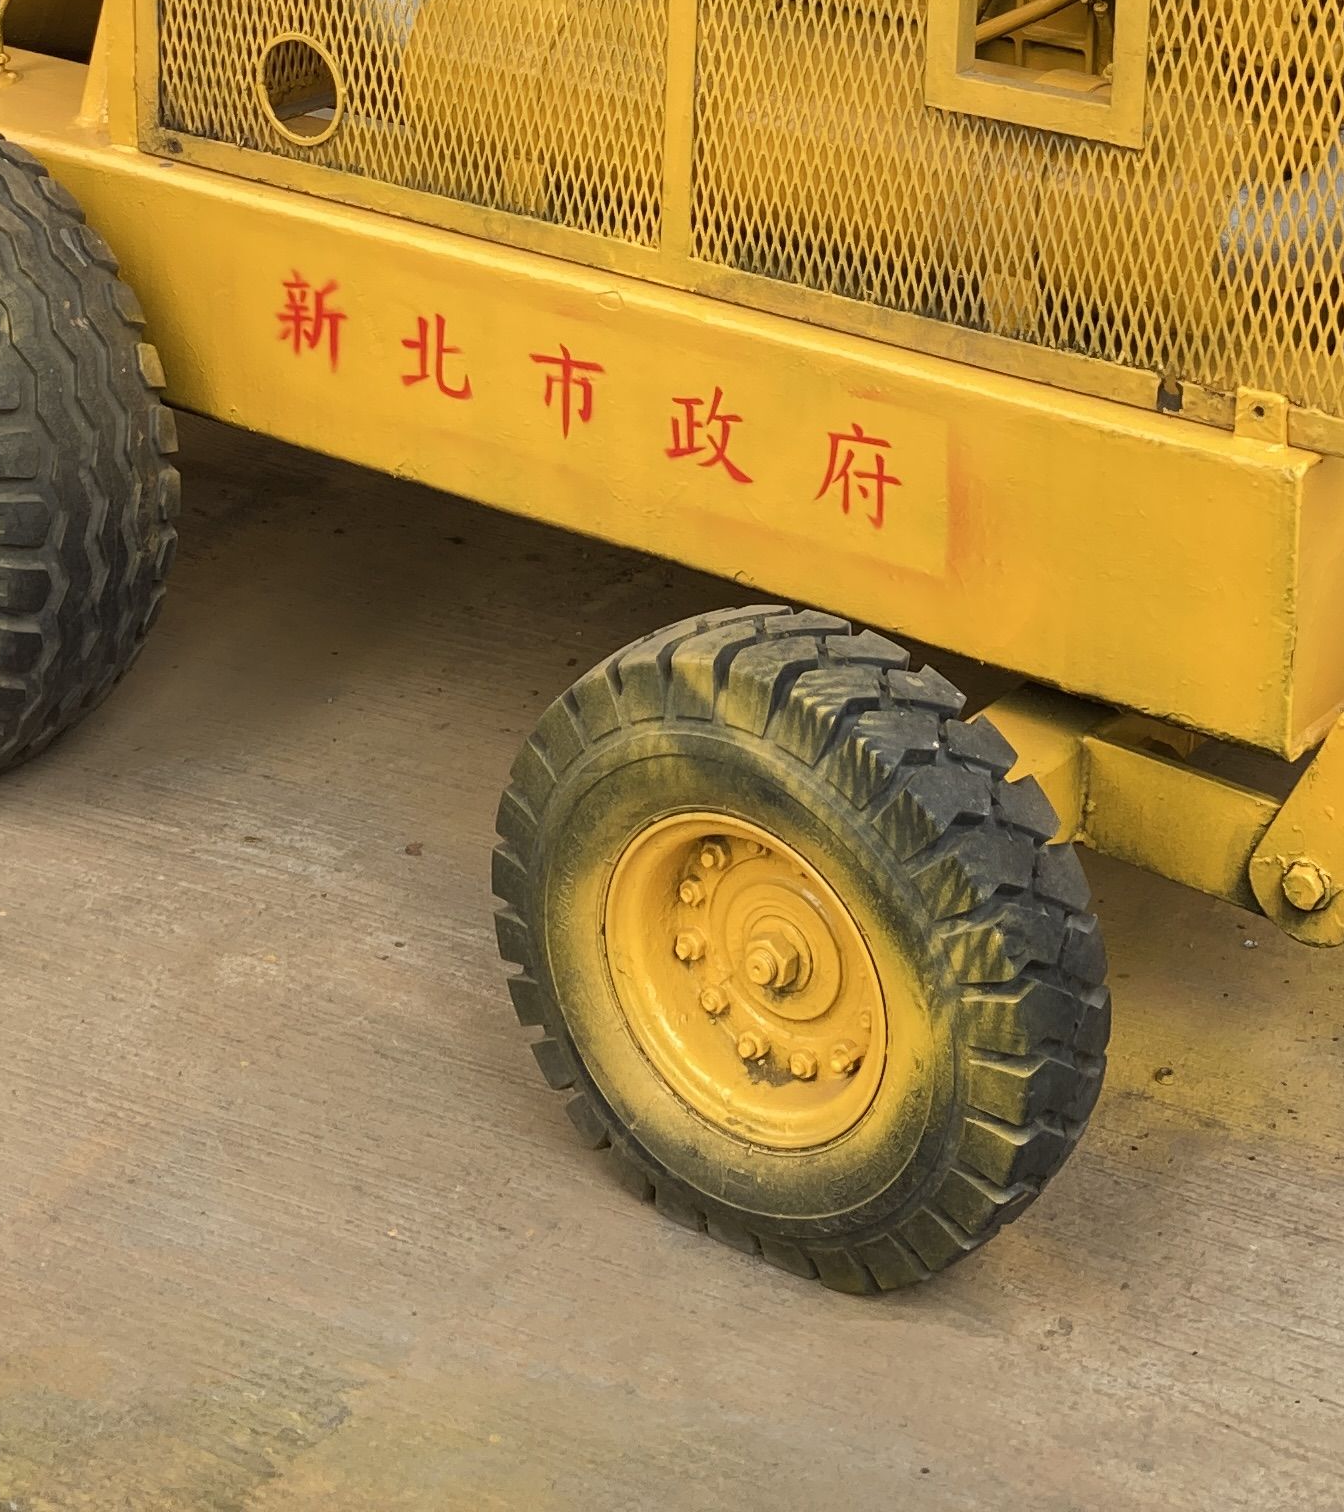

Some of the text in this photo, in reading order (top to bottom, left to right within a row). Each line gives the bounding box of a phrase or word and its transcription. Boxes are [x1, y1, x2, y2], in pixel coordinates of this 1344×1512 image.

[275, 269, 902, 529] 新北市政府
